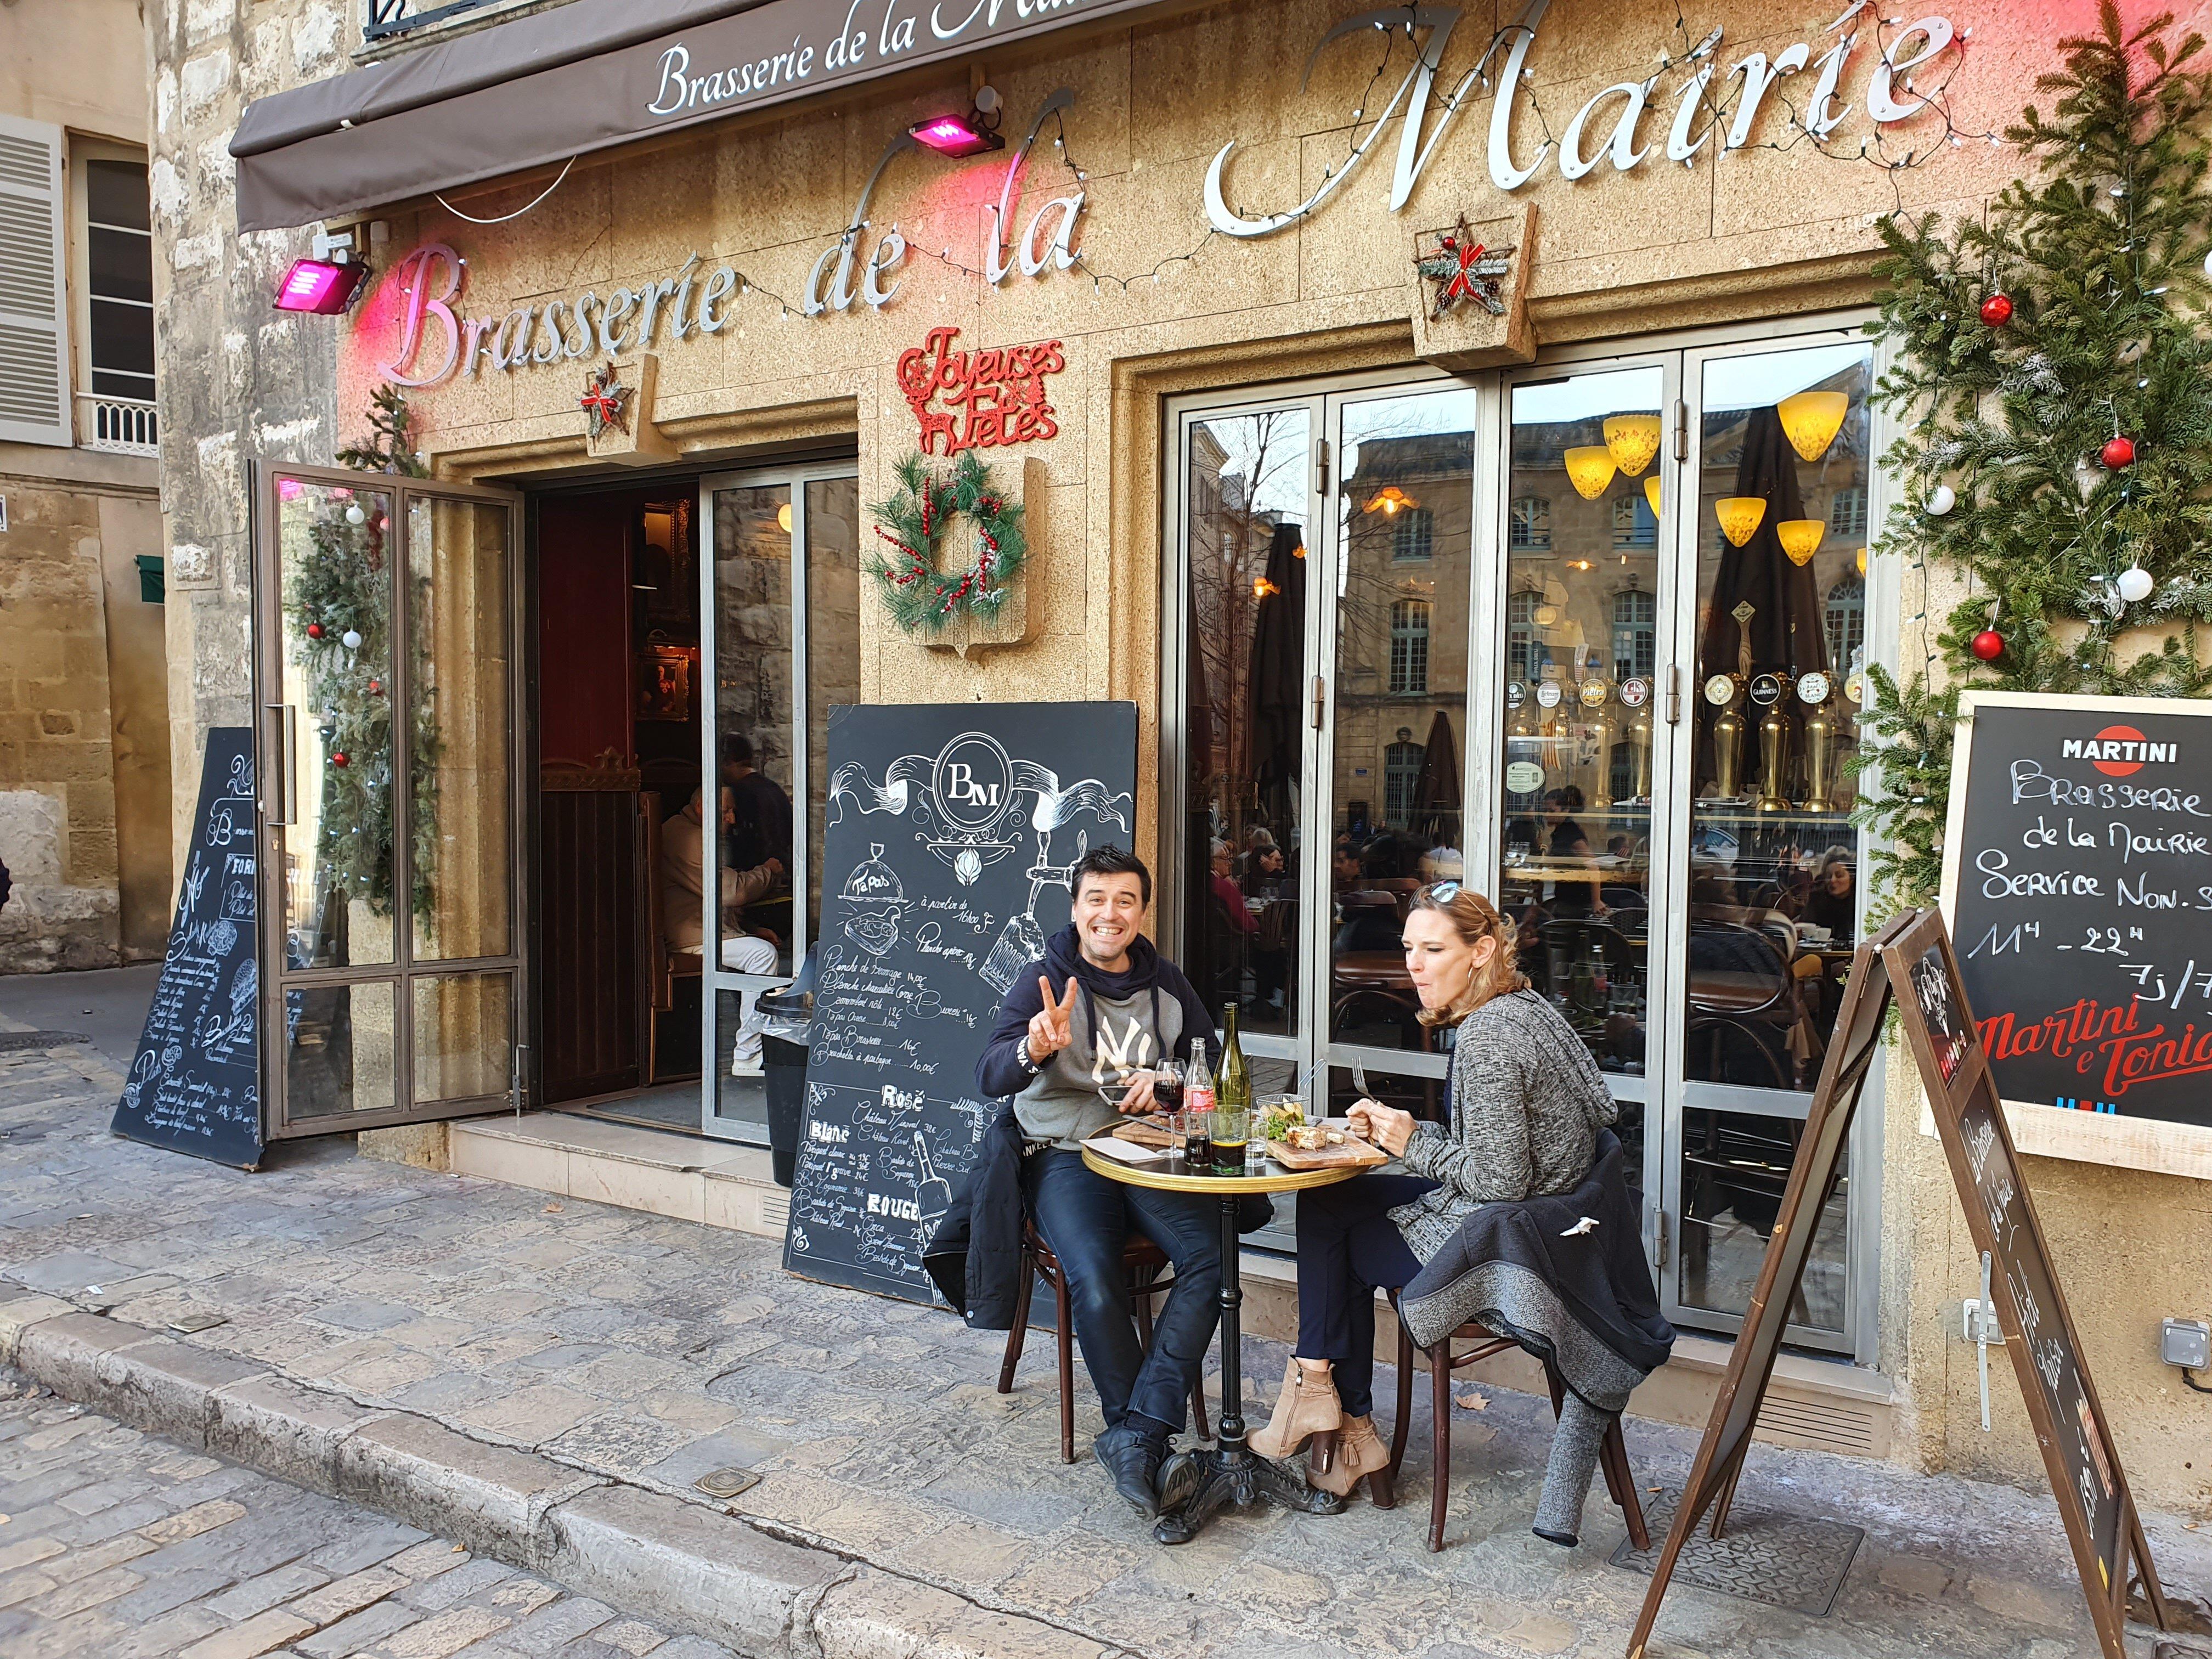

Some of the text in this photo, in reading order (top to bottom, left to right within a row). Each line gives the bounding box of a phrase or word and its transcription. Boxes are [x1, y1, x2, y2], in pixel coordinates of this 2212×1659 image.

[648, 34, 813, 115] Brasserie
[825, 0, 865, 70] de
[878, 0, 916, 56] la
[377, 0, 1954, 386] Brasserie de la Mairie
[897, 326, 1065, 396] Joyeuses
[1582, 687, 1605, 697] Pietra
[2063, 740, 2176, 763] MARTINI
[948, 764, 999, 807] BM
[2023, 815, 2058, 849] de
[2068, 817, 2097, 848] la
[852, 868, 890, 896] Tapas
[1976, 849, 2106, 899] Service
[921, 895, 968, 912] à partir de
[952, 910, 980, 924] 16h00
[916, 922, 943, 953] Planche
[823, 944, 858, 972] Planche
[860, 957, 871, 973] de
[819, 969, 860, 990] Planche
[817, 1007, 845, 1024] Tapas
[1975, 992, 2139, 1060] Martini
[815, 1022, 842, 1045] Tapas
[899, 1038, 922, 1057] 16€
[856, 1052, 863, 1062] à
[2076, 1050, 2094, 1074] e
[881, 1084, 925, 1111] Rosé
[851, 1100, 887, 1125] Château
[809, 1119, 851, 1143] Blanc
[906, 1158, 915, 1167] de
[867, 1193, 919, 1222] ROUGE
